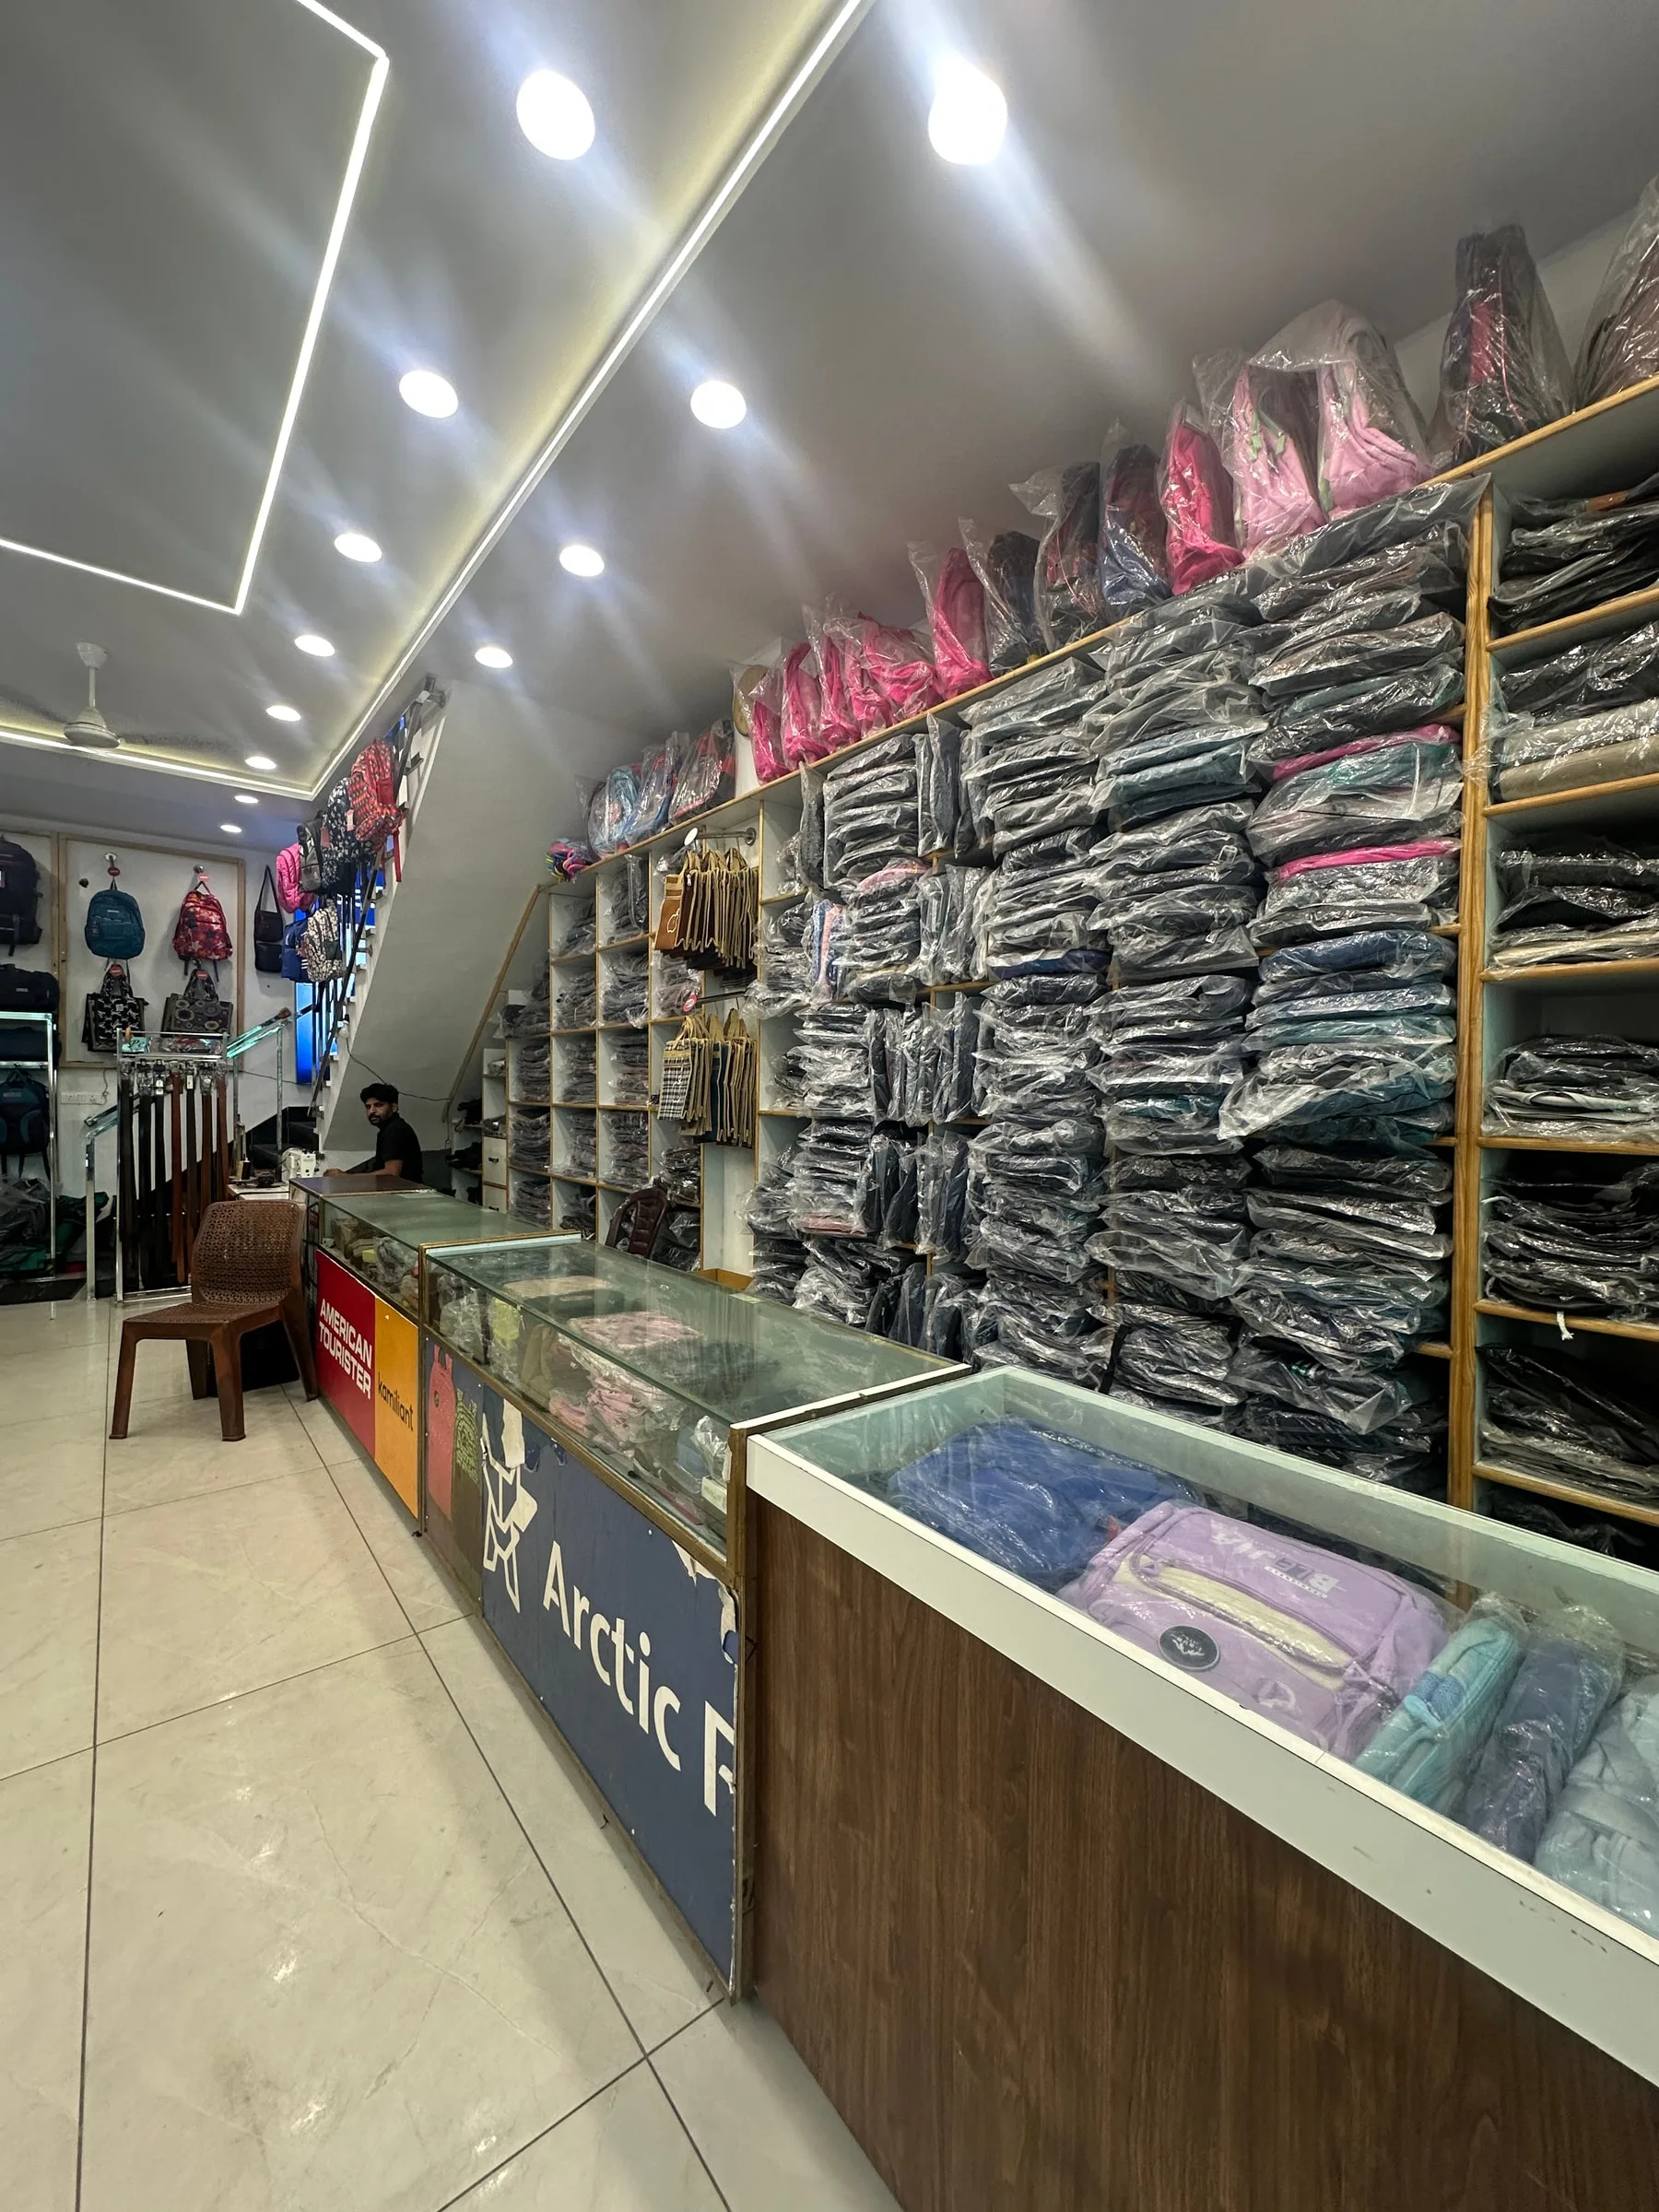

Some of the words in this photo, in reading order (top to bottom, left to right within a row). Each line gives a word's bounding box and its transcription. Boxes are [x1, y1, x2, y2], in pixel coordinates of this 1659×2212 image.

[319, 1320, 371, 1400] TOURISTER
[320, 1298, 372, 1370] AMERICAN
[378, 1371, 414, 1432] kamiliant
[543, 1540, 681, 1771] Arctic
